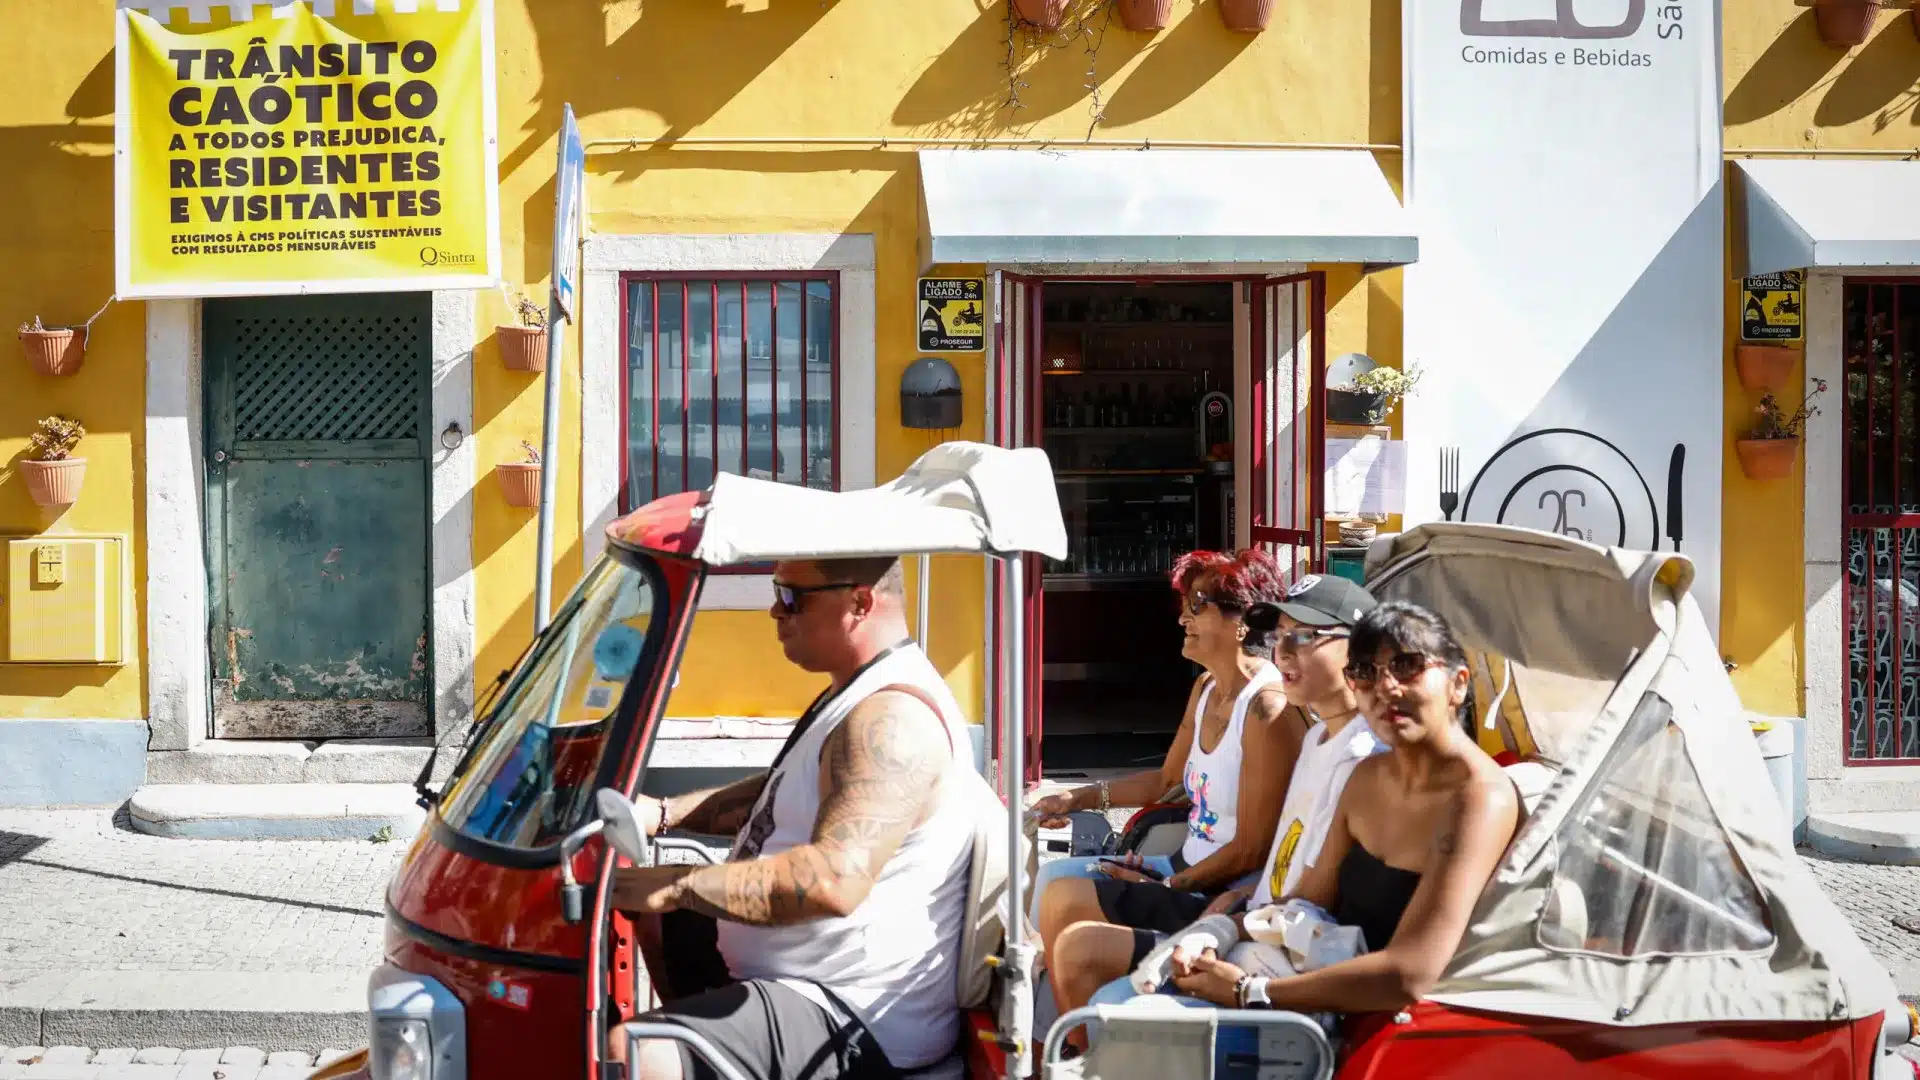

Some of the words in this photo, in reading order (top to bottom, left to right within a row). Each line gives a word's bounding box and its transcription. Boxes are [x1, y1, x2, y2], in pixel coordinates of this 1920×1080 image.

[169, 37, 437, 81] TRÂNSITO
[1461, 46, 1548, 65] Comidas
[1554, 52, 1566, 65] e
[1573, 48, 1652, 67] Bebidas
[169, 74, 438, 126] CAÓTICO
[169, 133, 187, 151] A
[193, 130, 286, 150] TODOS
[293, 126, 446, 149] PREJUDICA,
[170, 151, 441, 189] RESIDENTES
[170, 197, 191, 224] E
[201, 189, 442, 223] VISITANTES
[171, 234, 233, 244] EXIGIMOS
[236, 231, 246, 242] À
[249, 232, 275, 242] CMS
[278, 229, 346, 241] POLÍTICAS
[349, 226, 442, 239] SUSTENTÁVEIS
[171, 245, 199, 255] COM
[203, 243, 283, 255] RESULTADOS
[287, 240, 377, 252] MENSURÁVEIS
[925, 281, 962, 289] ALARME
[925, 288, 962, 296] LIGADO
